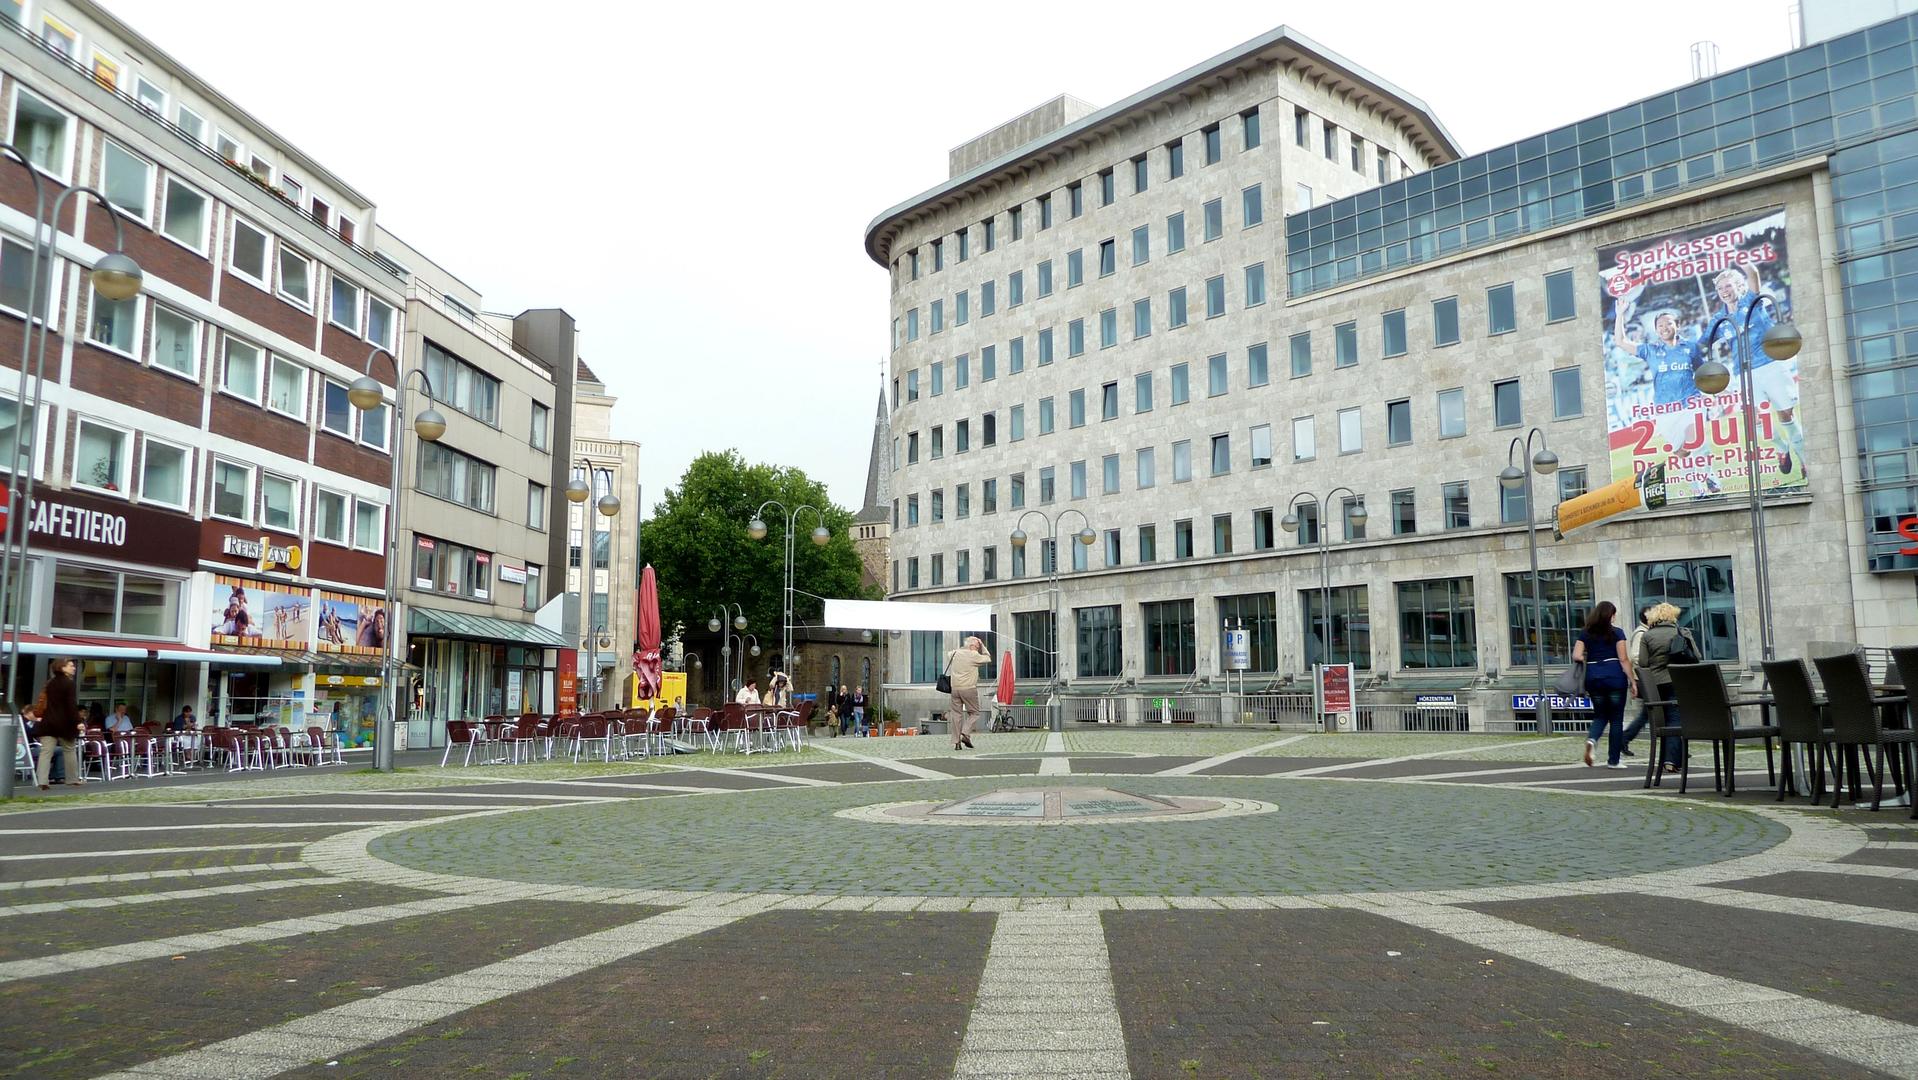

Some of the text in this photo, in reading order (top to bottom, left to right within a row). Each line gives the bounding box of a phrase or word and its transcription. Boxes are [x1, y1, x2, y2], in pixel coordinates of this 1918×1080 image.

[1615, 231, 1744, 271] Sparkassen
[1640, 243, 1774, 284] FußballFest
[1632, 402, 1682, 417] Feiern
[1687, 397, 1712, 409] Sie
[1632, 420, 1673, 456] 2.
[1633, 447, 1776, 474] DrRuer-Platz
[1645, 485, 1665, 499] FIEGE
[1518, 694, 1585, 708] HÖERTE
